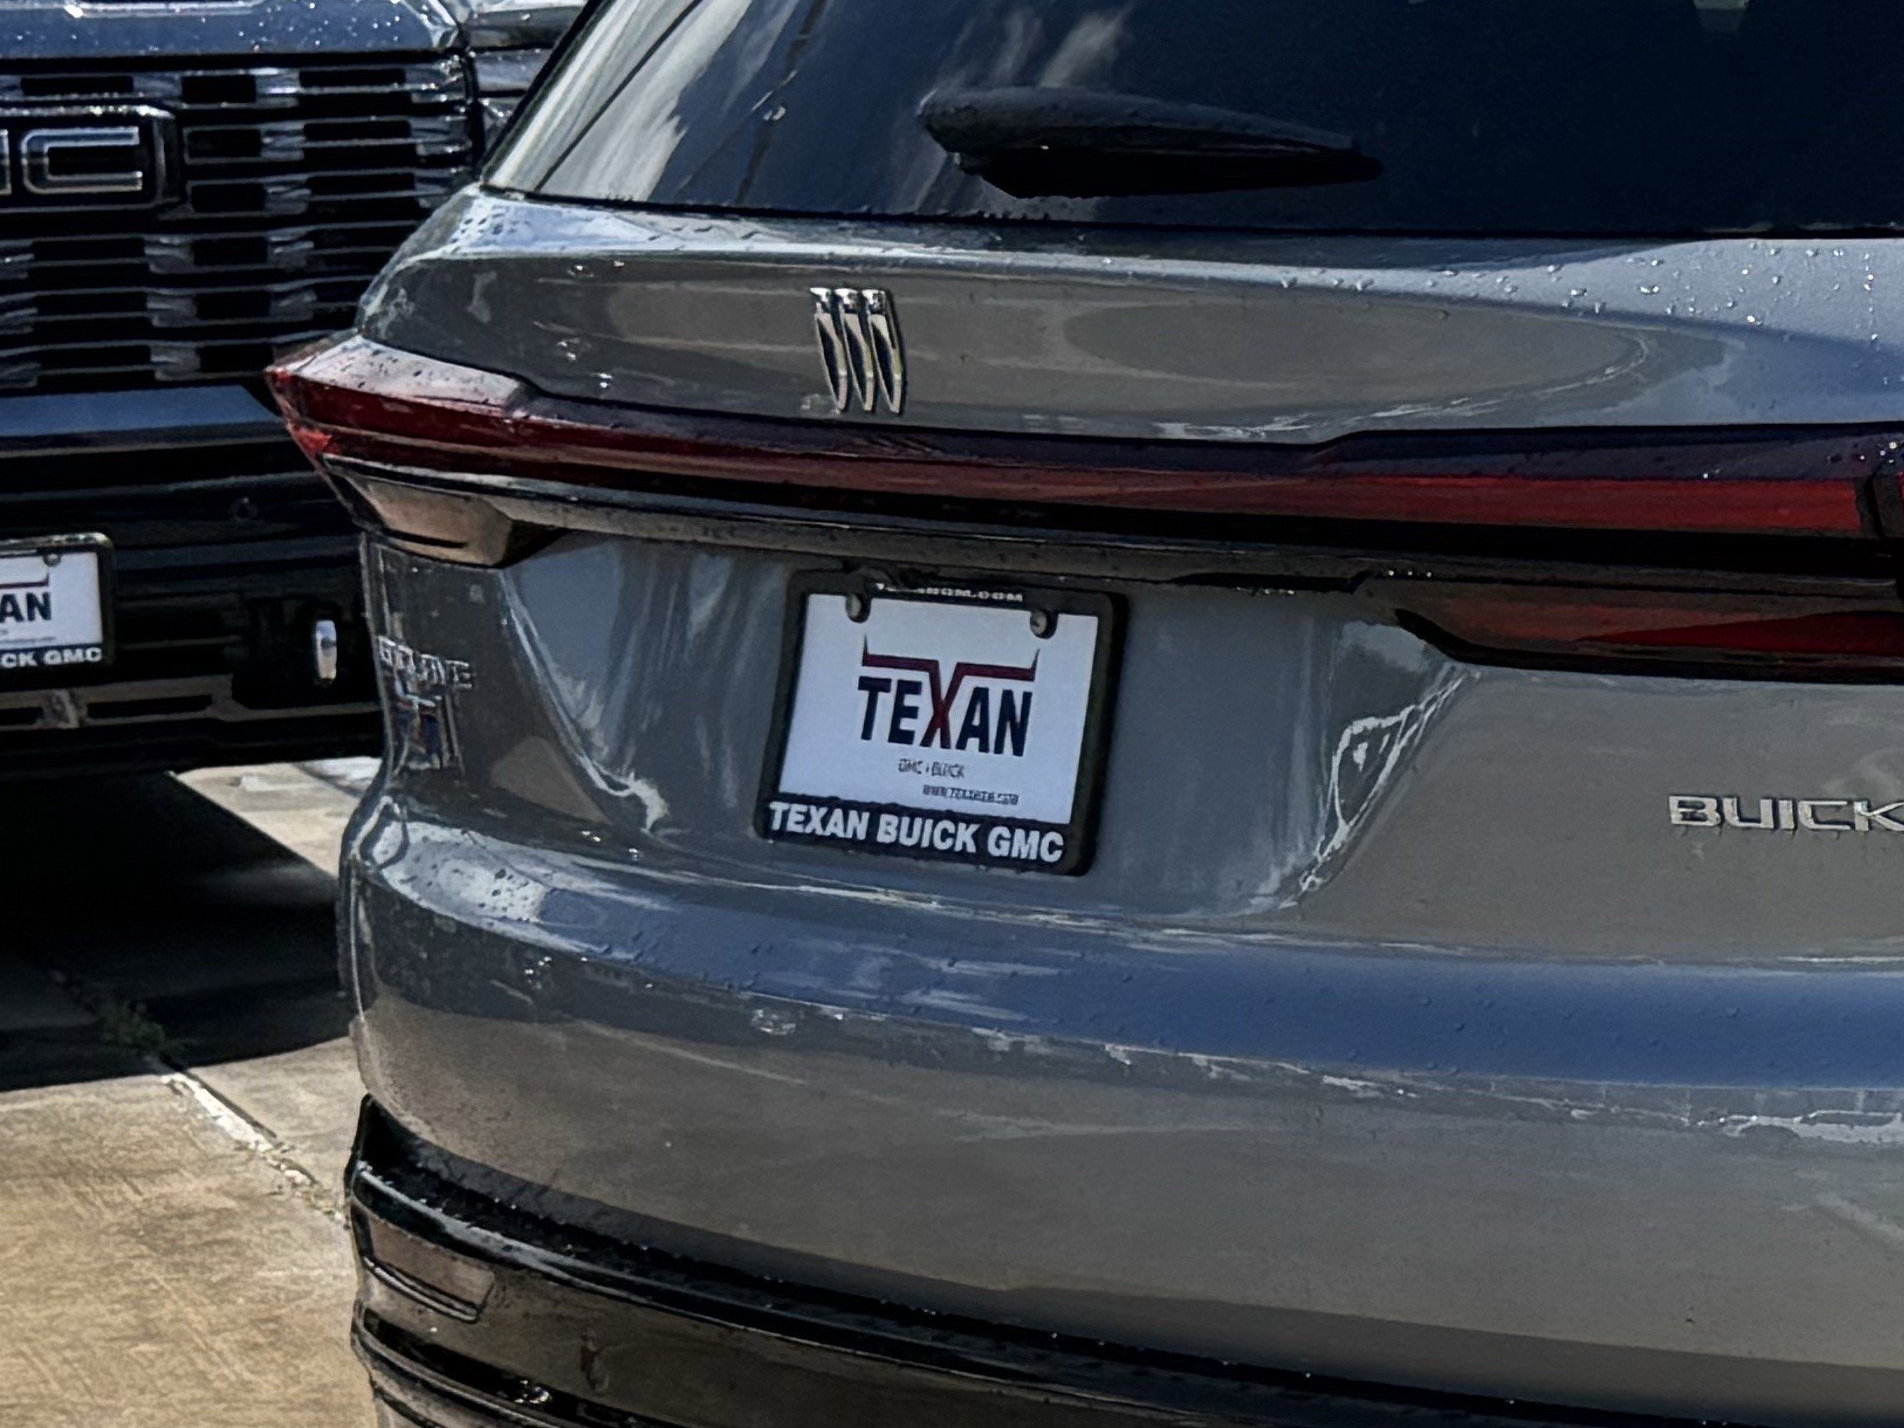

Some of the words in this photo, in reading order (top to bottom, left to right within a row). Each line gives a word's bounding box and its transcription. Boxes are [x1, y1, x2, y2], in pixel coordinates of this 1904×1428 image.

[43, 647, 102, 666] GMC
[857, 644, 1037, 757] TEXAN
[768, 802, 870, 841] TEXAN
[876, 814, 979, 854] BUICK
[987, 827, 1065, 863] GMC
